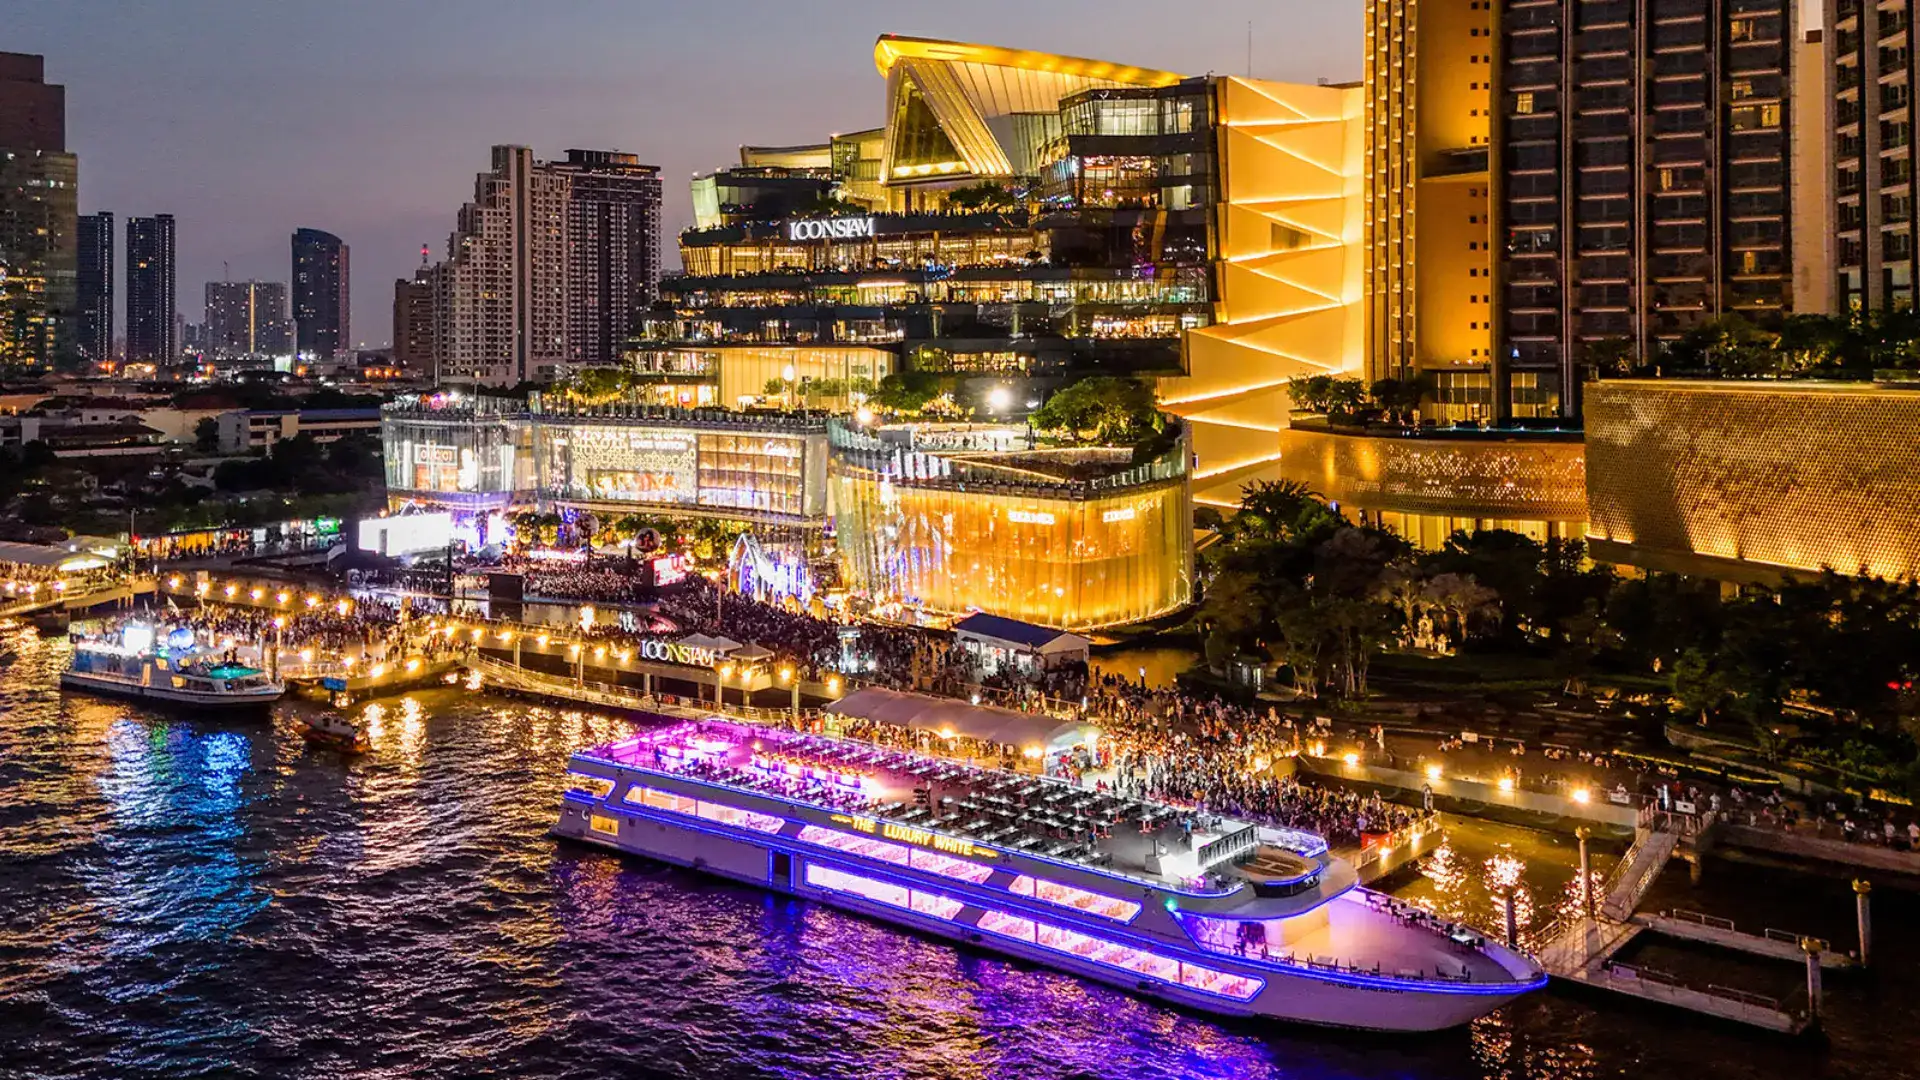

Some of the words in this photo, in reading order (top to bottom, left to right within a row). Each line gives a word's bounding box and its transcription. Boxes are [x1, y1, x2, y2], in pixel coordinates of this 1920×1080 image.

[789, 218, 875, 240] ICONSIAM
[640, 640, 715, 668] ICONSIAM
[851, 815, 876, 834] THE
[883, 823, 932, 846] LUXURY
[933, 833, 974, 857] WHITE
